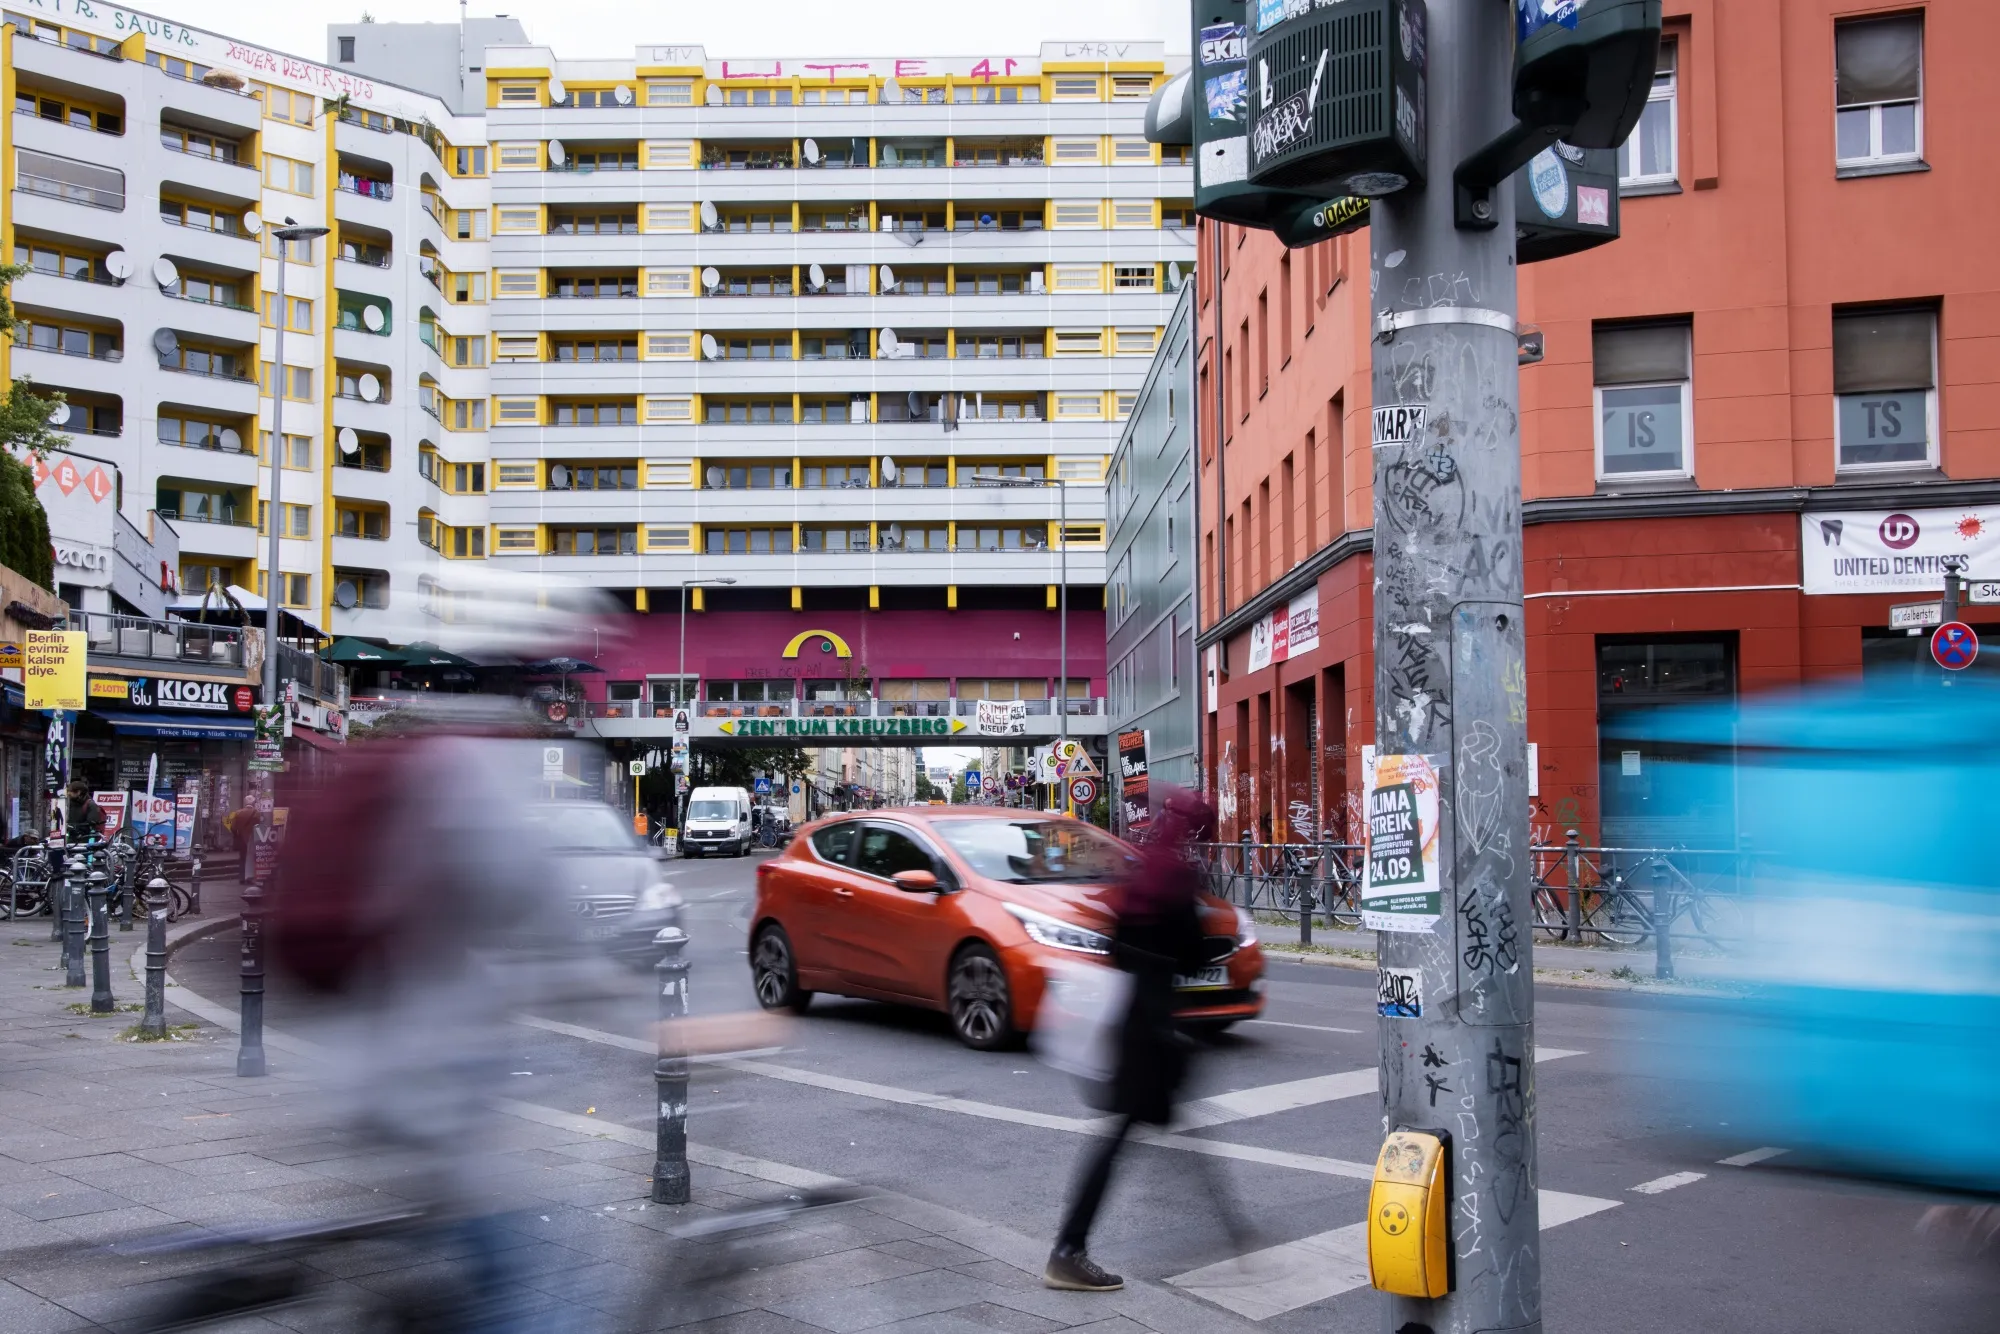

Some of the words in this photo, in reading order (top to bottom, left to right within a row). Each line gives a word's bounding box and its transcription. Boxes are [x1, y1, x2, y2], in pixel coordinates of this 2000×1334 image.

[1202, 37, 1247, 62] SKA
[1861, 400, 1902, 439] TS
[1834, 558, 1889, 576] UNITED
[1982, 584, 2000, 597] Sk
[1899, 608, 1935, 621] dalbertstr.
[28, 633, 65, 643] Berlin
[28, 644, 70, 654] evimiz
[28, 655, 65, 665] kalsın
[28, 666, 57, 677] diye.
[102, 684, 126, 694] LOTTO
[157, 679, 229, 703] KIOSK
[28, 698, 44, 707] Ja!
[132, 687, 152, 706] blu
[979, 712, 1009, 725] KRISE
[157, 728, 179, 736] Türkçe
[182, 729, 199, 737] Kitap
[737, 719, 828, 735] ZENTRUM
[835, 718, 948, 735] KREUZBERG
[1074, 785, 1090, 798] 30
[1371, 789, 1411, 817] KLIMA
[1371, 812, 1413, 836] STREIK
[1371, 857, 1418, 883] 24.09.
[1390, 903, 1427, 911] klima-streik.org
